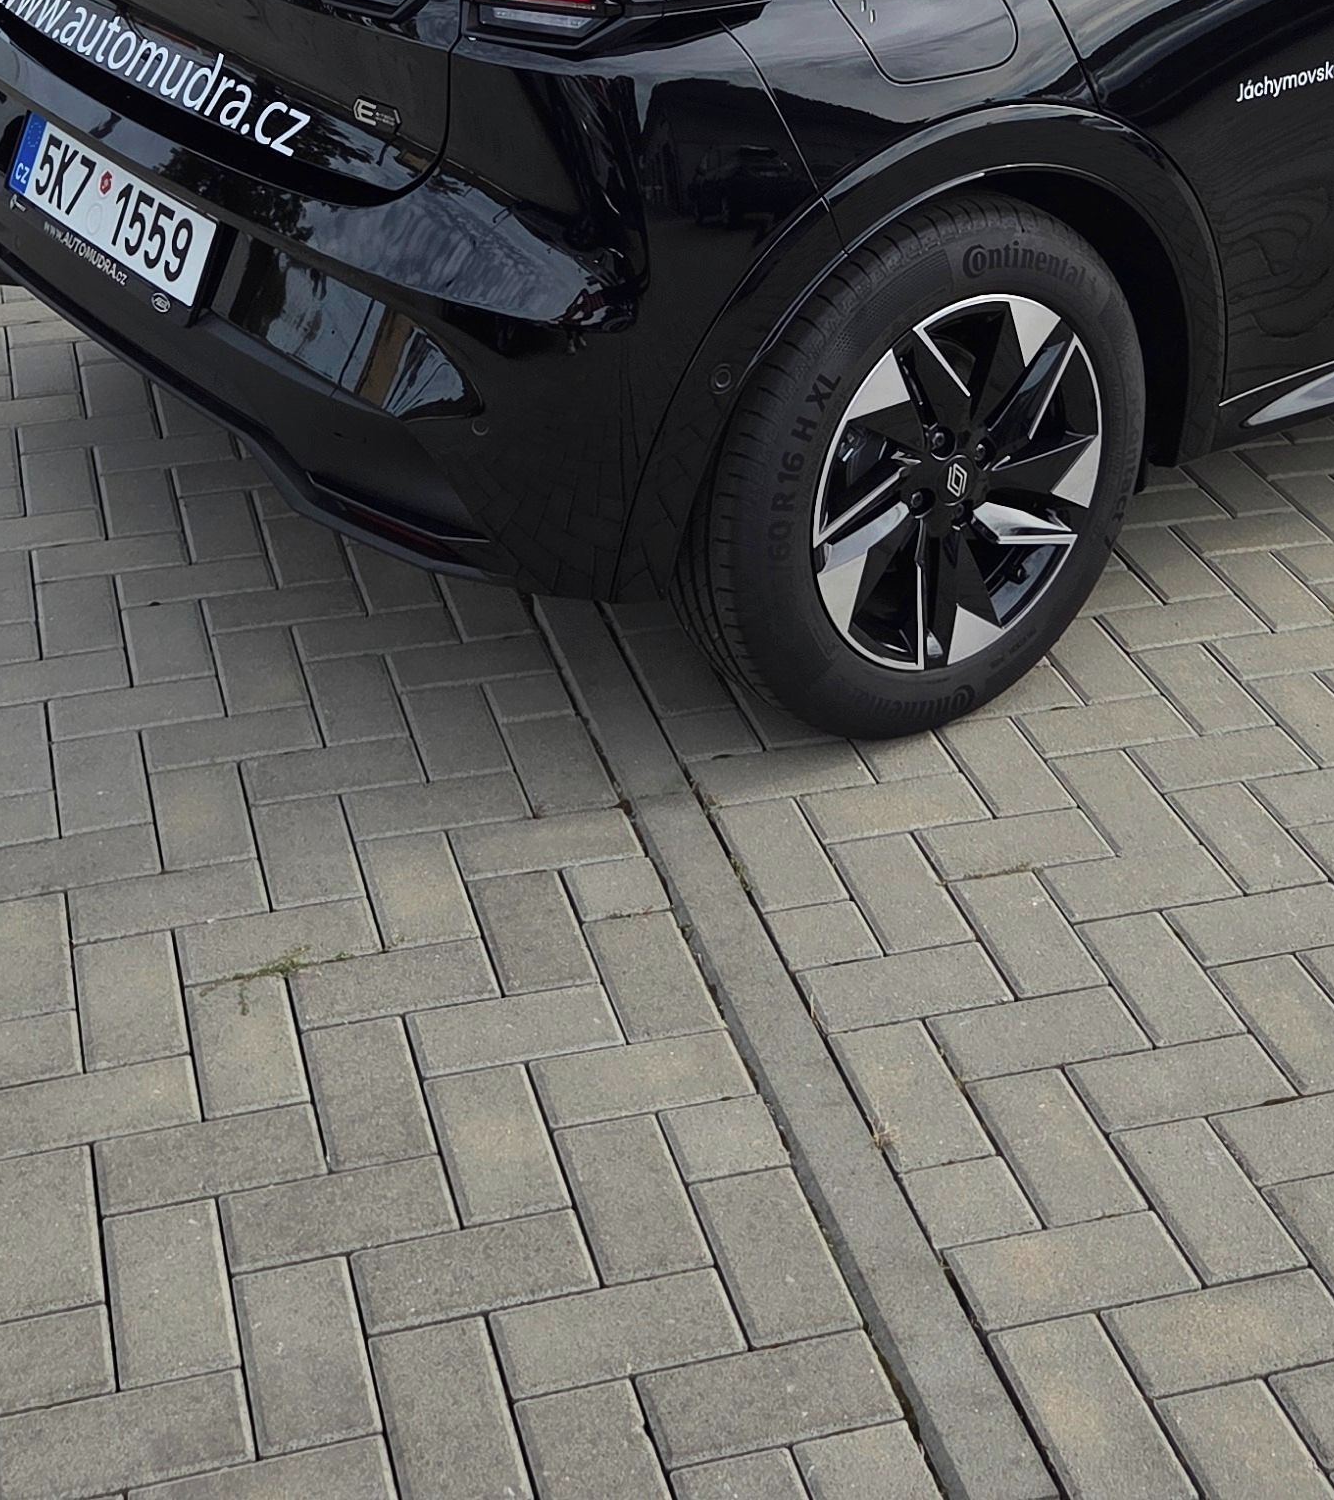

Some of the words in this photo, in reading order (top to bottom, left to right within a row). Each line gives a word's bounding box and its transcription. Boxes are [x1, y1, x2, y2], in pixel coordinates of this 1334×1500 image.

[15, 162, 31, 184] CZ
[35, 133, 97, 216] 5K7
[111, 183, 193, 282] 1559
[805, 372, 842, 414] XL
[789, 416, 818, 443] H
[777, 451, 804, 483] 16
